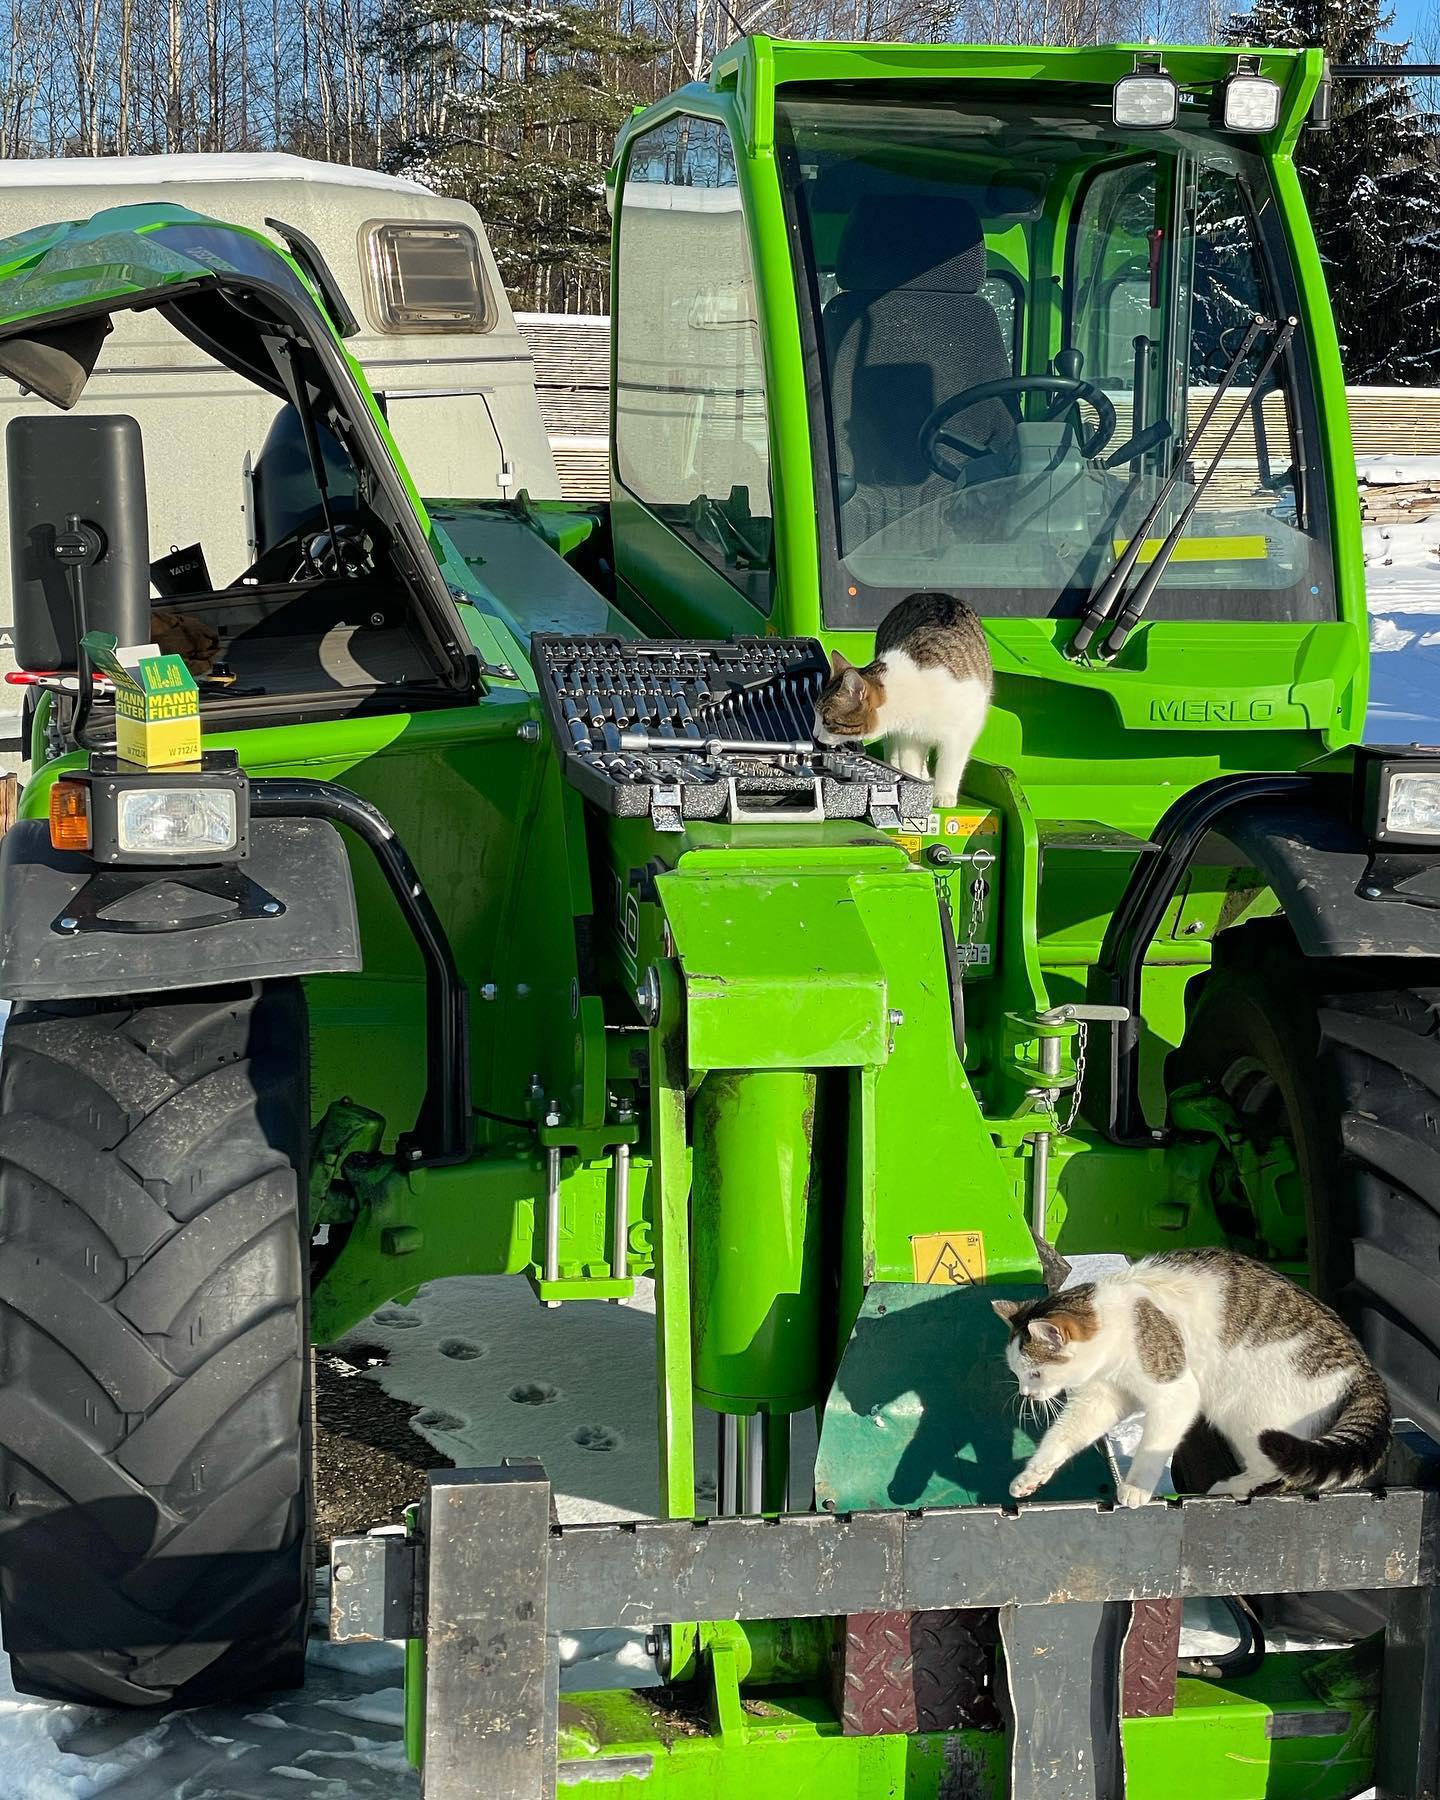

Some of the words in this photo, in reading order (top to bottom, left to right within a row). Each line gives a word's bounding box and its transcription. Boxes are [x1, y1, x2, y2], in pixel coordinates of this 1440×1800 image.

[169, 563, 191, 576] YATO
[116, 688, 145, 708] MANN
[148, 691, 197, 708] MANN
[116, 703, 145, 720] FILTER
[149, 704, 198, 720] FILTER
[1150, 699, 1275, 722] MERLO
[179, 746, 198, 757] 712/4
